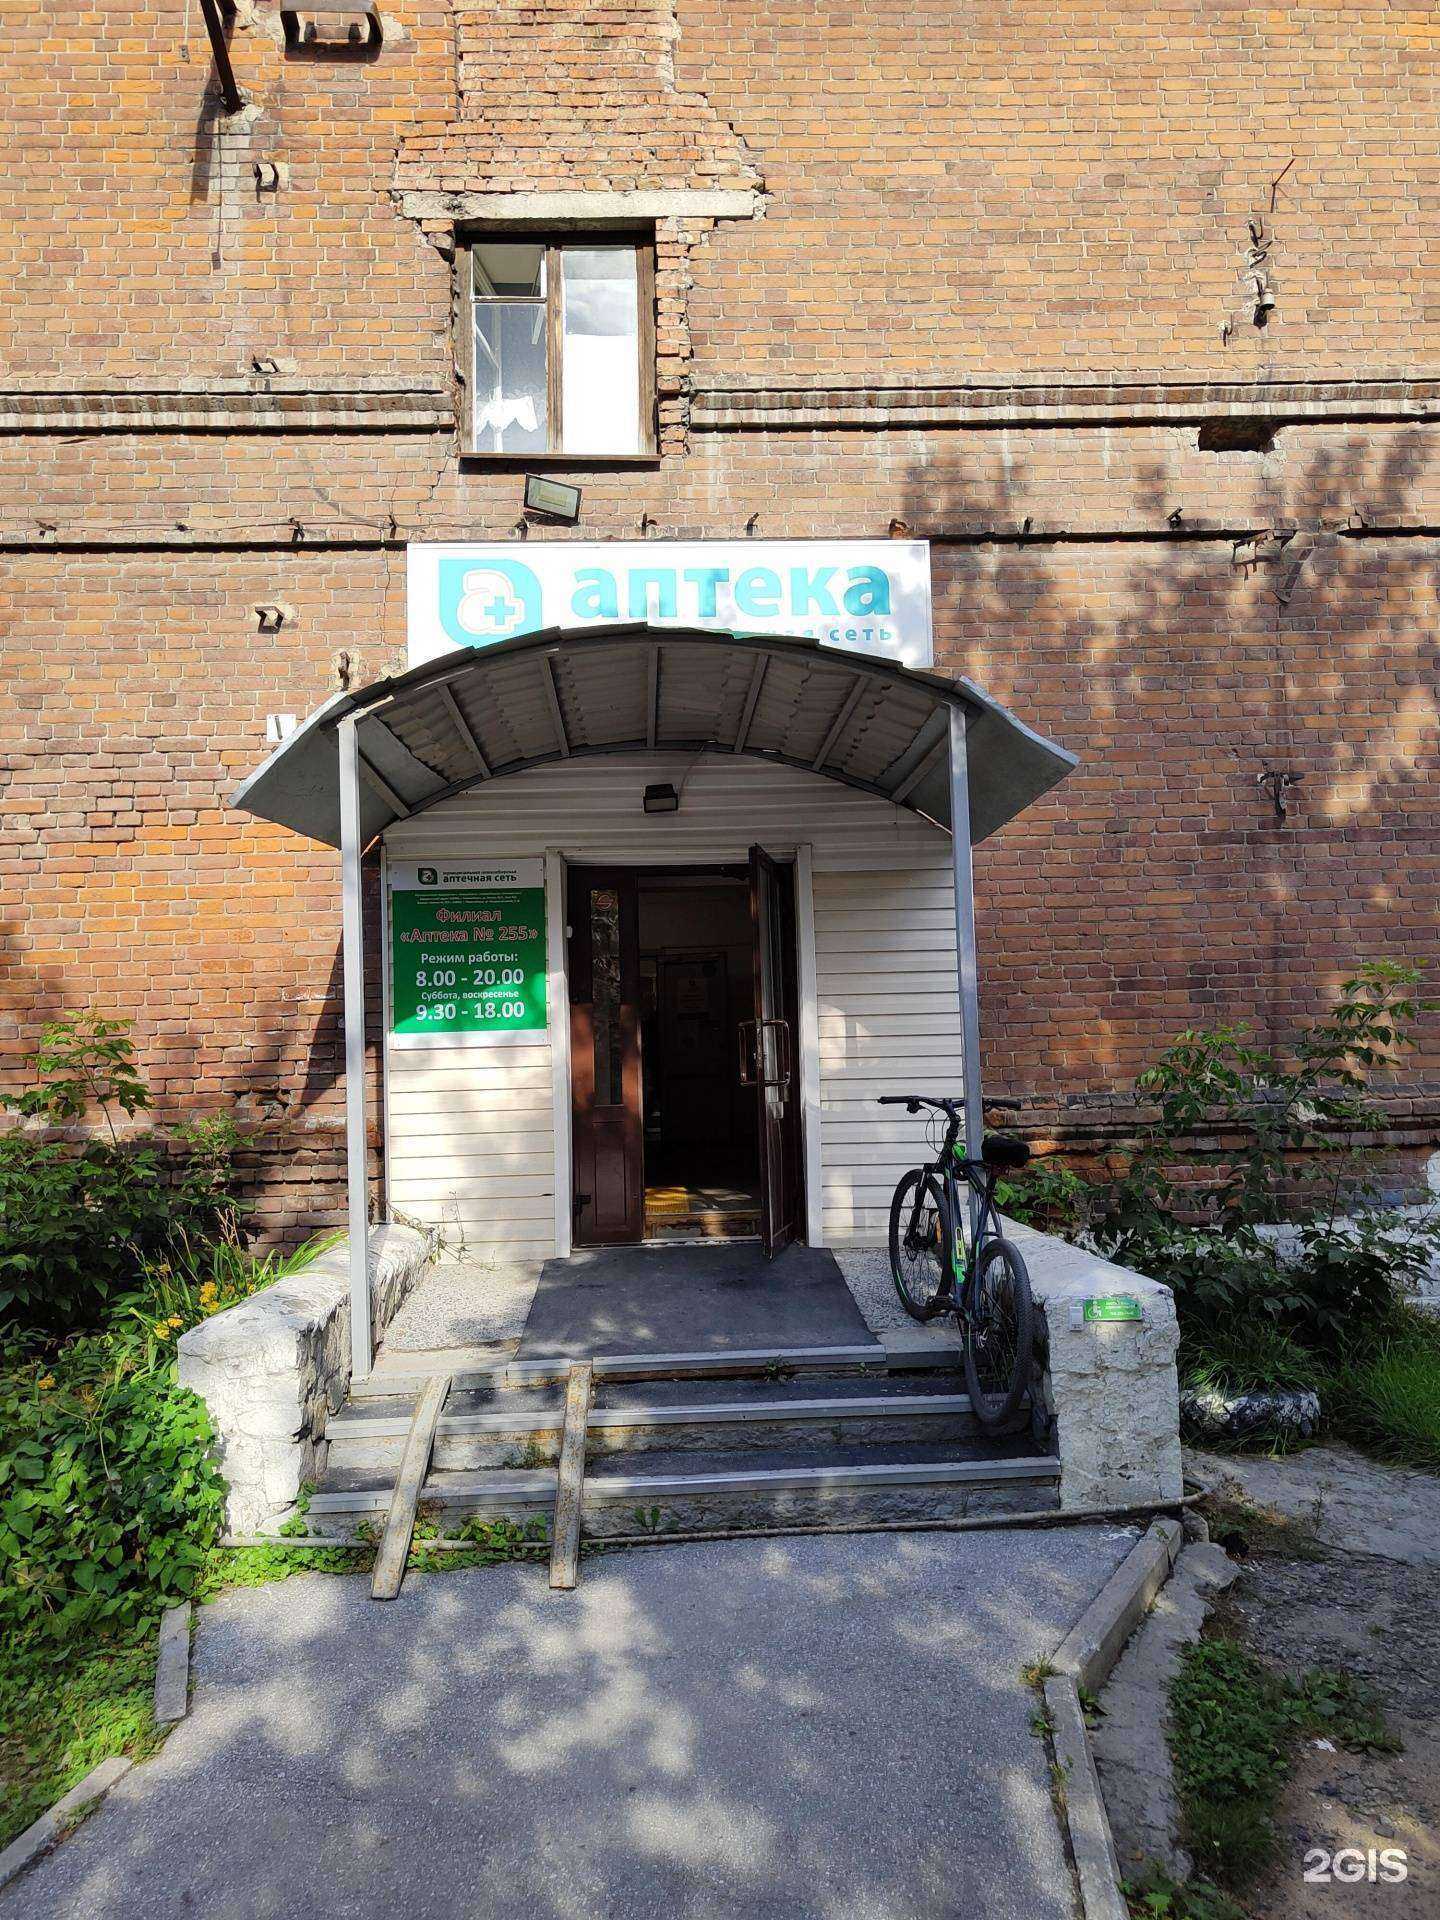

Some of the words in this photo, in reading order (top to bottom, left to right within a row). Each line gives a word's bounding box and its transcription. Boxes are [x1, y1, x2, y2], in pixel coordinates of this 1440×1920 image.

[570, 565, 891, 619] аптека
[829, 628, 893, 642] сеть
[443, 874, 492, 883] аптечная
[494, 873, 517, 882] сеть
[436, 907, 502, 923] Филиал
[400, 927, 469, 943] «Аптека
[473, 926, 494, 941] №
[498, 925, 539, 941] 255»
[421, 953, 465, 964] Режим
[468, 951, 519, 965] работы:
[415, 970, 456, 987] 8.00
[473, 968, 525, 985] 20.00
[421, 991, 461, 1001] Суббота,
[462, 990, 520, 999] воскресенье
[415, 1003, 457, 1021] 9.30
[473, 1001, 526, 1019] 18.00
